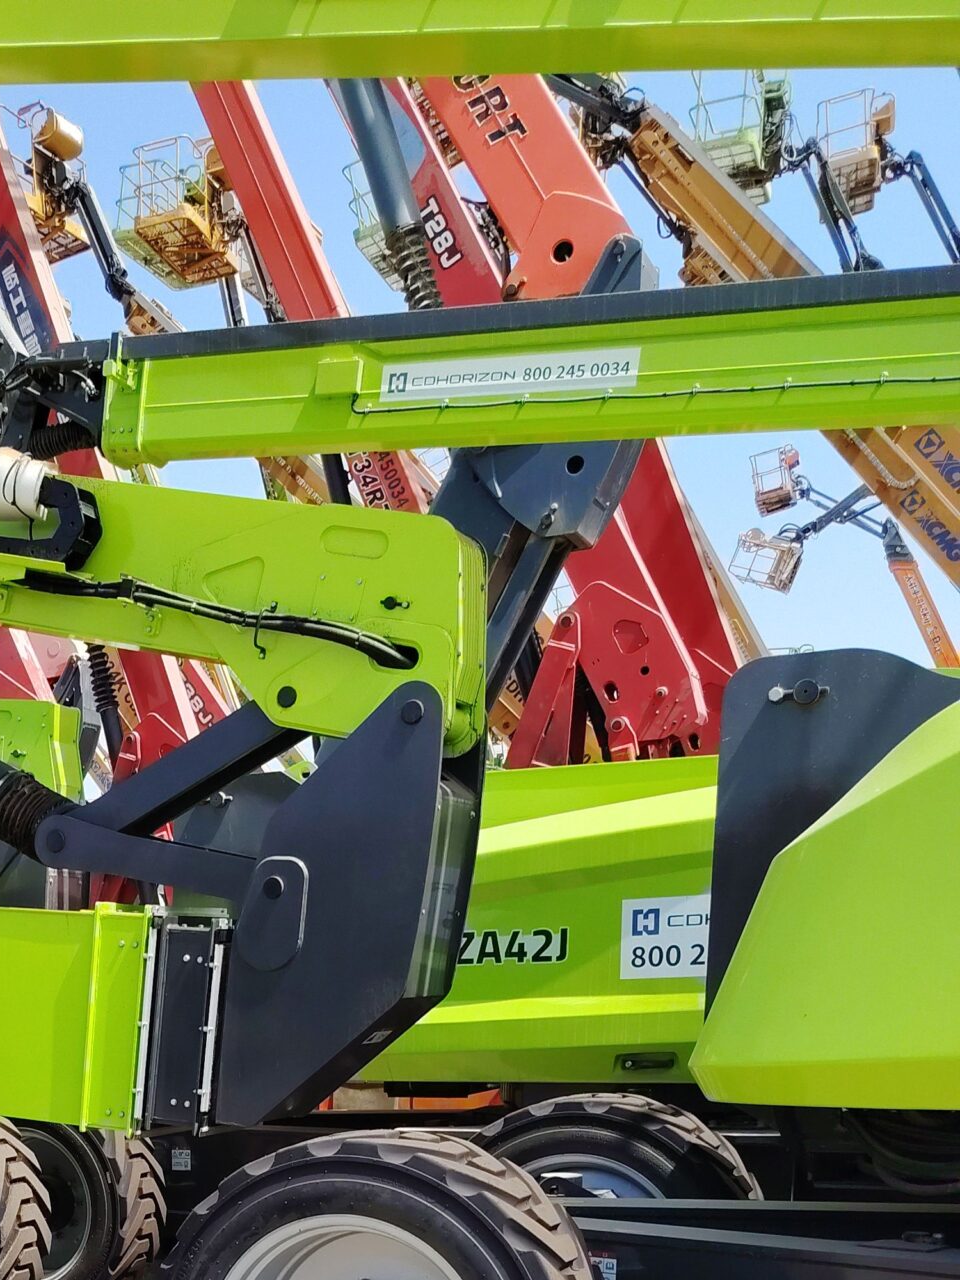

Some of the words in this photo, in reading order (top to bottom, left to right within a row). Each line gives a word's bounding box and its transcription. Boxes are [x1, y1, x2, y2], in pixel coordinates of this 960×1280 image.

[419, 196, 464, 270] T28J
[522, 366, 552, 382] 800
[555, 363, 585, 380] 245
[590, 360, 631, 377] 0034
[374, 451, 407, 509] 450034
[457, 927, 569, 965] ZA42J
[631, 944, 681, 968] 800
